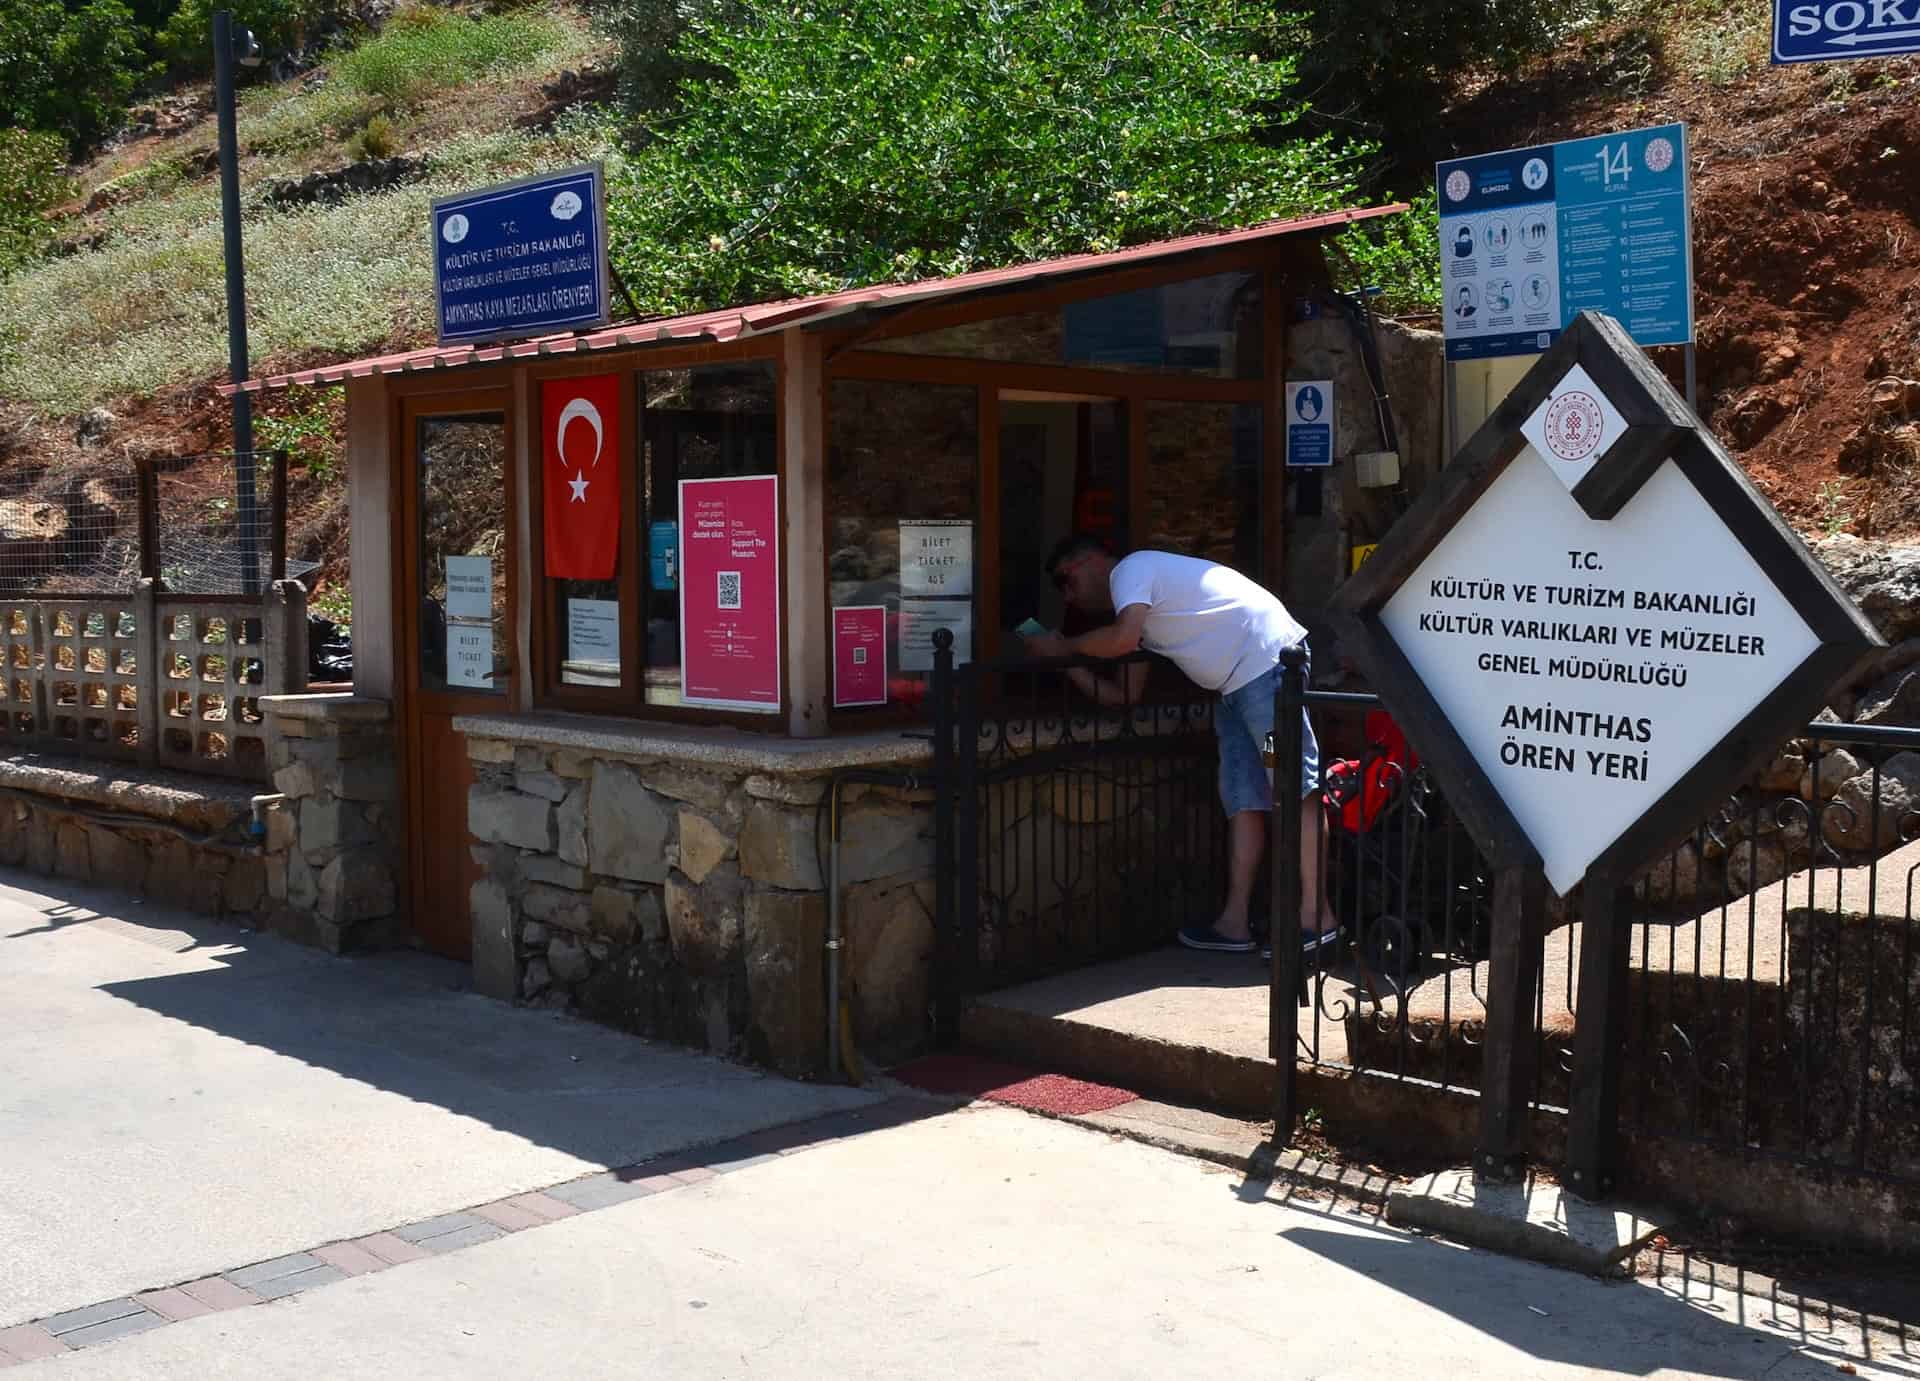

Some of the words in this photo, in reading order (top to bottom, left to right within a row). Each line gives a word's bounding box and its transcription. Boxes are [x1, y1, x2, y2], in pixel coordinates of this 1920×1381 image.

[1789, 0, 1920, 36] SOK
[1595, 141, 1632, 185] 14
[501, 221, 519, 235] T.C.
[446, 249, 480, 270] KÜLTÜR
[480, 248, 493, 263] VE
[532, 230, 585, 254] BAKANLIĞI
[1569, 552, 1602, 570] T.C.
[1431, 576, 1504, 600] KÜLTÜR
[1513, 585, 1536, 602] VE
[1545, 584, 1624, 608] TURİZM
[1634, 592, 1755, 616] BAKANLIĞI
[1420, 611, 1493, 635] KÜLTÜR
[1502, 620, 1616, 644] VARLIKLARI
[1626, 628, 1651, 647] VE
[1661, 627, 1764, 656] MÜZELER
[1479, 653, 1540, 674] GENEL
[1549, 656, 1686, 687] MÜDÜRLÜĞÜ
[1501, 702, 1651, 744] AMİNTHAS
[1501, 736, 1574, 772] ÖREN
[1587, 751, 1648, 781] YERİ
